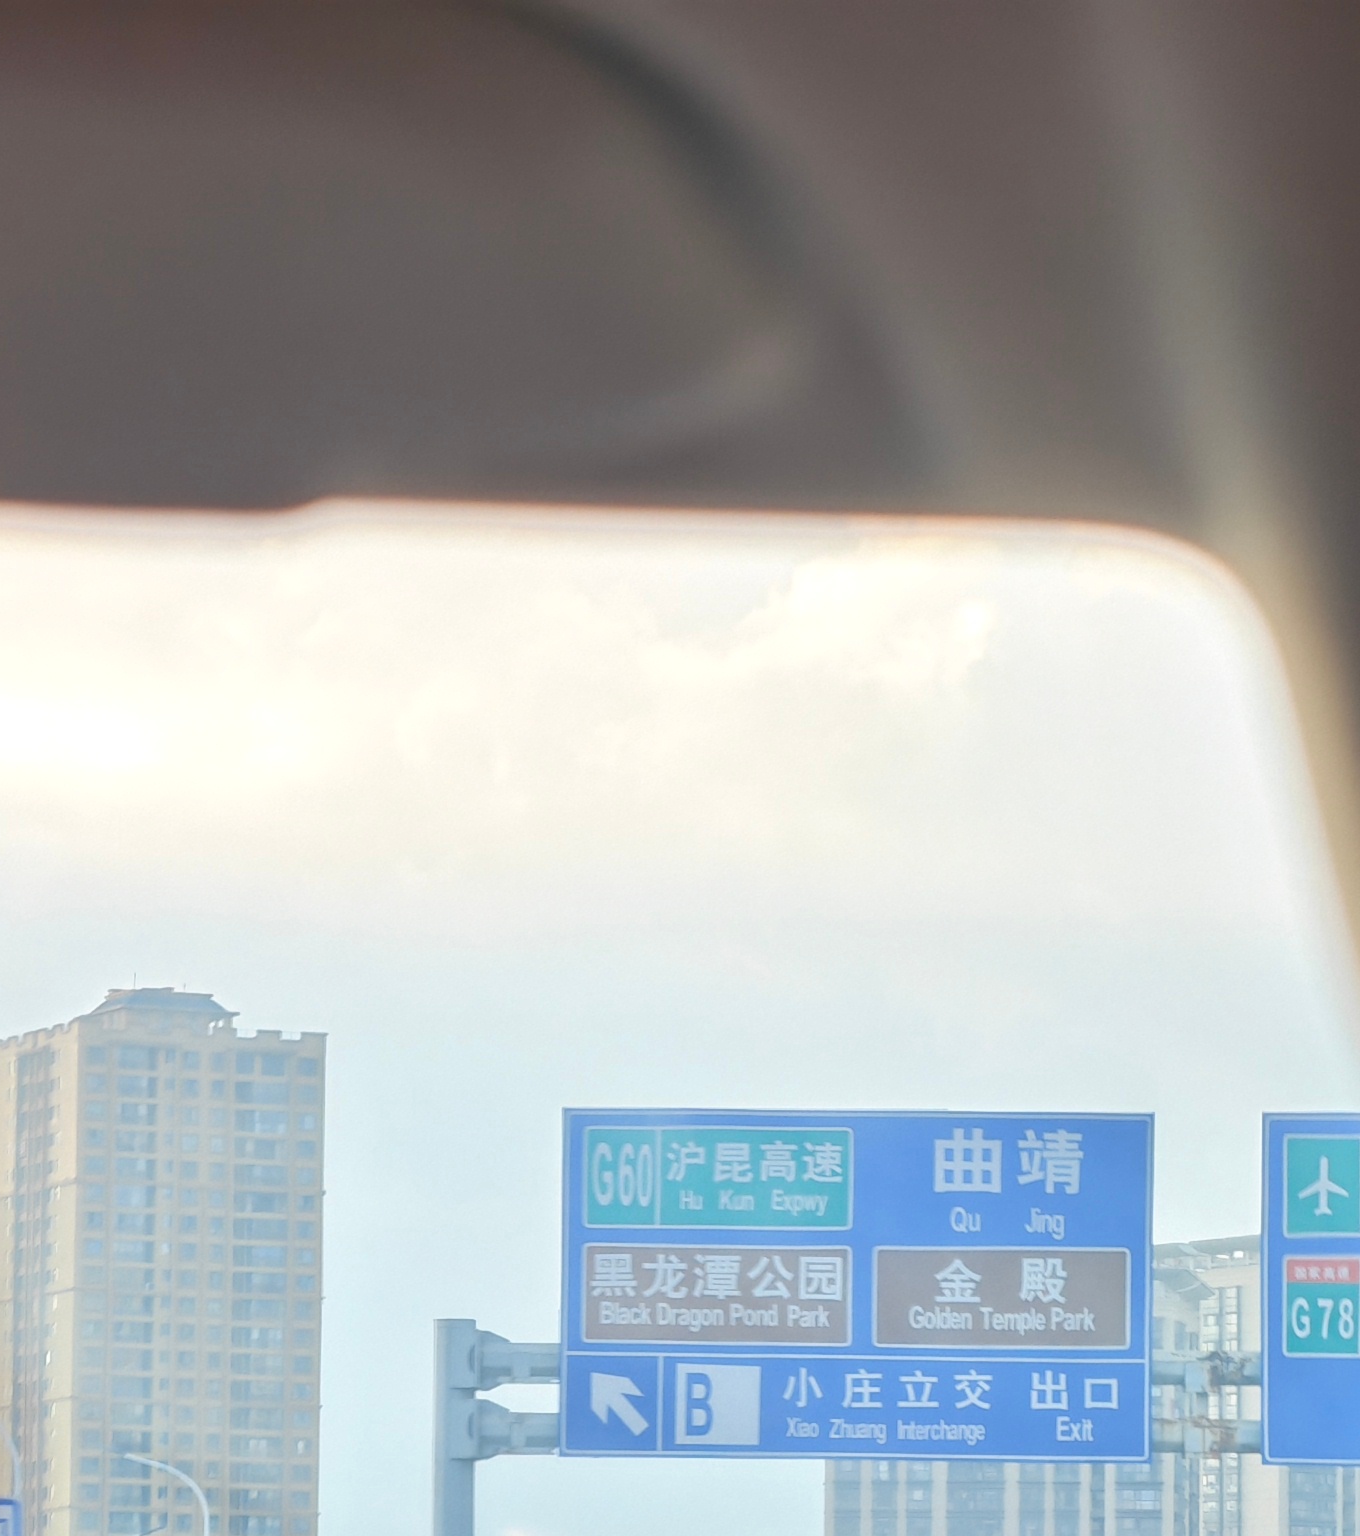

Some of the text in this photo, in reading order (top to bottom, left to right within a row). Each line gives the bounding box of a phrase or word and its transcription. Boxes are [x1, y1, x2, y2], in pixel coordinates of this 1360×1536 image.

[593, 1141, 653, 1207] G60
[666, 1140, 844, 1183] 沪昆高速
[933, 1127, 1084, 1194] 曲靖
[679, 1189, 828, 1216] Hu Kun Expwy
[950, 1207, 1065, 1240] Qu Jing
[590, 1253, 844, 1300] 黑龙潭公园
[934, 1258, 1068, 1304] 金殿
[599, 1301, 830, 1332] Black Dragon Pond Park
[908, 1306, 1095, 1335] Golden Temple Park
[1291, 1297, 1355, 1340] G78
[685, 1372, 713, 1436] B
[783, 1367, 1119, 1411] 小庄立交 出口
[786, 1416, 1094, 1445] Xiao Zhuang Interchange Exit
